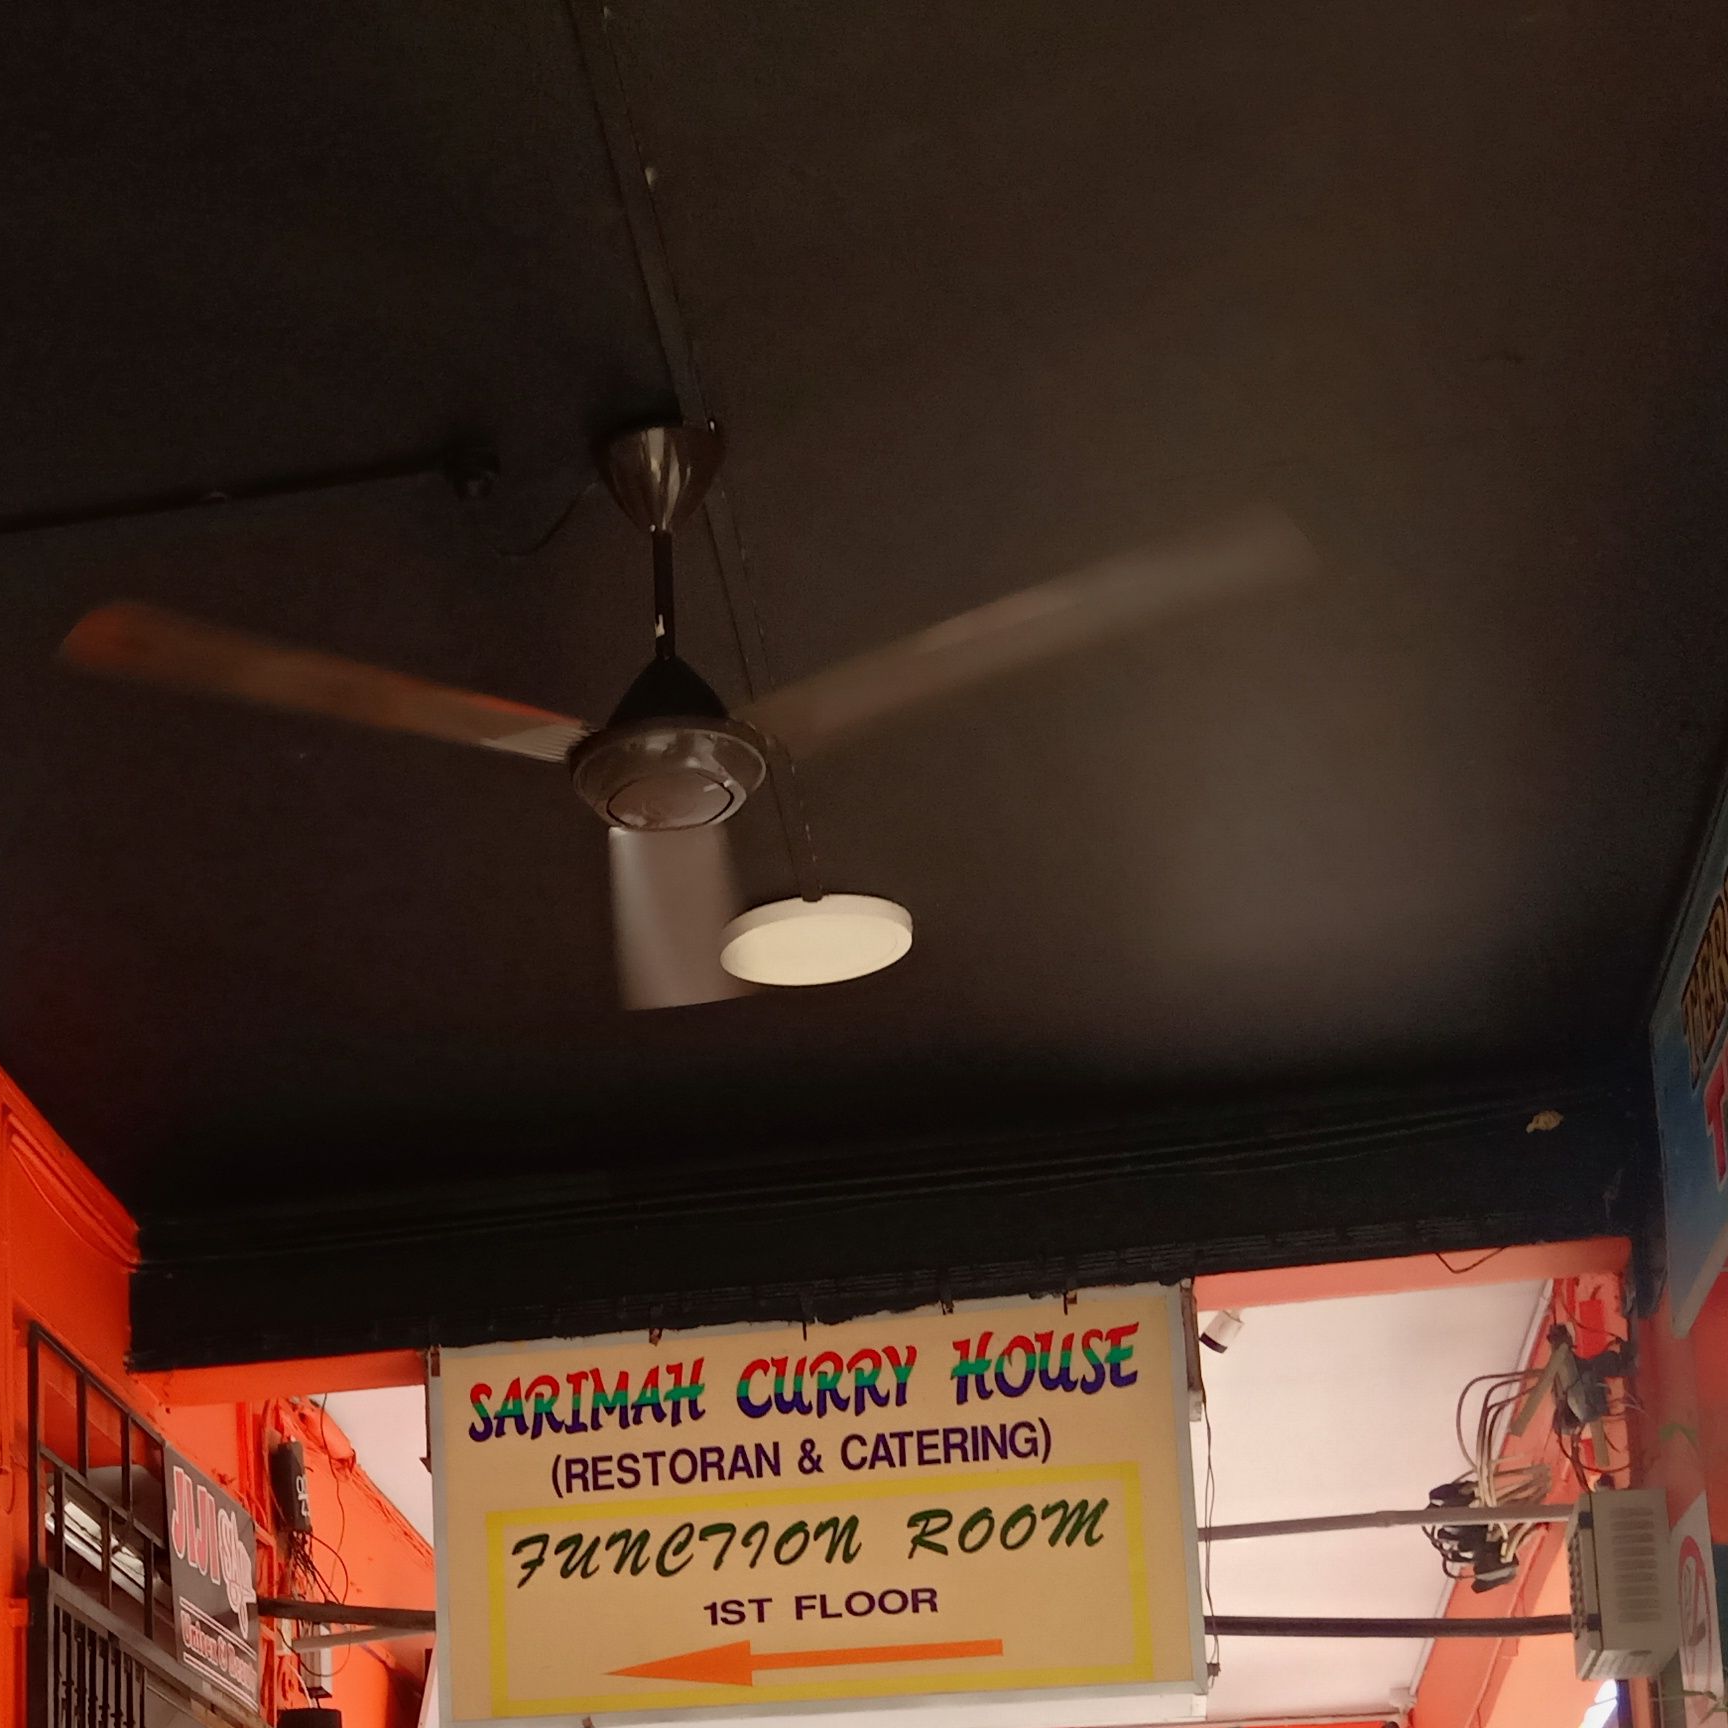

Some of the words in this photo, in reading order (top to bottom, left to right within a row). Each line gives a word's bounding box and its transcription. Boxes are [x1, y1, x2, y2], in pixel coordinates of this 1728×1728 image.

[468, 1357, 706, 1443] SARIMAH
[735, 1345, 918, 1421] CURRY
[952, 1321, 1140, 1405] HOUSE
[549, 1439, 783, 1500] (RESTORAN
[799, 1441, 823, 1476] &
[841, 1417, 1053, 1469] CATERING)
[511, 1513, 862, 1589] FUNCTION
[907, 1497, 1110, 1562] ROOM
[703, 1597, 773, 1627] 1ST
[793, 1587, 940, 1622] FLOOR
